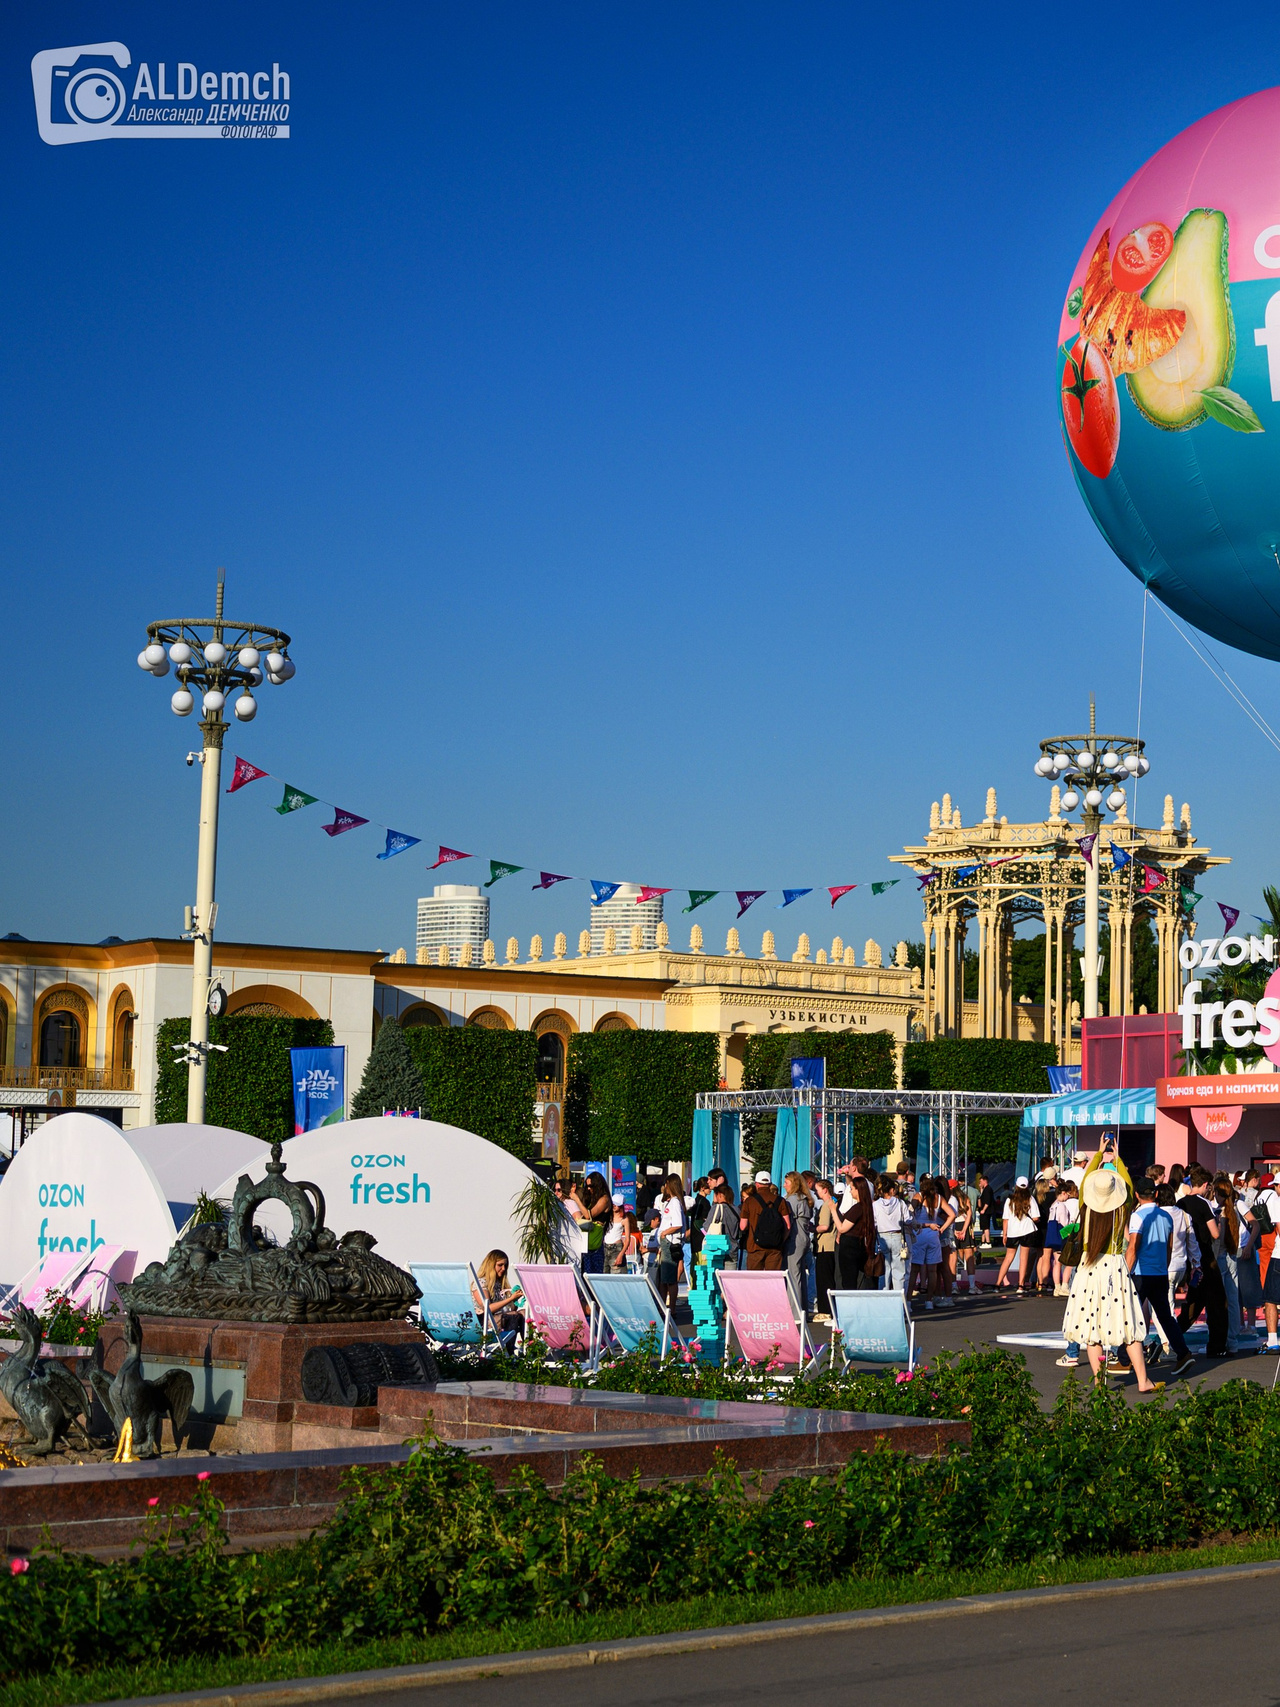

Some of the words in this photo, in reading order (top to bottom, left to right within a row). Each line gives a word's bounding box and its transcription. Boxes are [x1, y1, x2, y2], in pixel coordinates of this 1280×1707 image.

[1179, 934, 1274, 969] OZON
[769, 1009, 867, 1025] УЗБЕКИСТАН
[1166, 1084, 1194, 1099] Горячая
[1196, 1085, 1213, 1096] еда
[1216, 1086, 1223, 1094] и
[1226, 1083, 1279, 1094] напитки
[1069, 1111, 1090, 1122] fresh
[1093, 1112, 1112, 1121] квиз
[1205, 1118, 1232, 1136] fresh
[350, 1154, 405, 1168] OZON
[350, 1172, 431, 1204] fresh
[38, 1183, 85, 1207] OZON
[534, 1304, 561, 1315] ONLY
[427, 1311, 460, 1321] FRESH
[547, 1314, 579, 1323] FRESH
[737, 1312, 769, 1322] ONLY
[753, 1322, 789, 1331] FRESH
[742, 1330, 776, 1340] VIBES
[848, 1338, 887, 1346] FRESH
